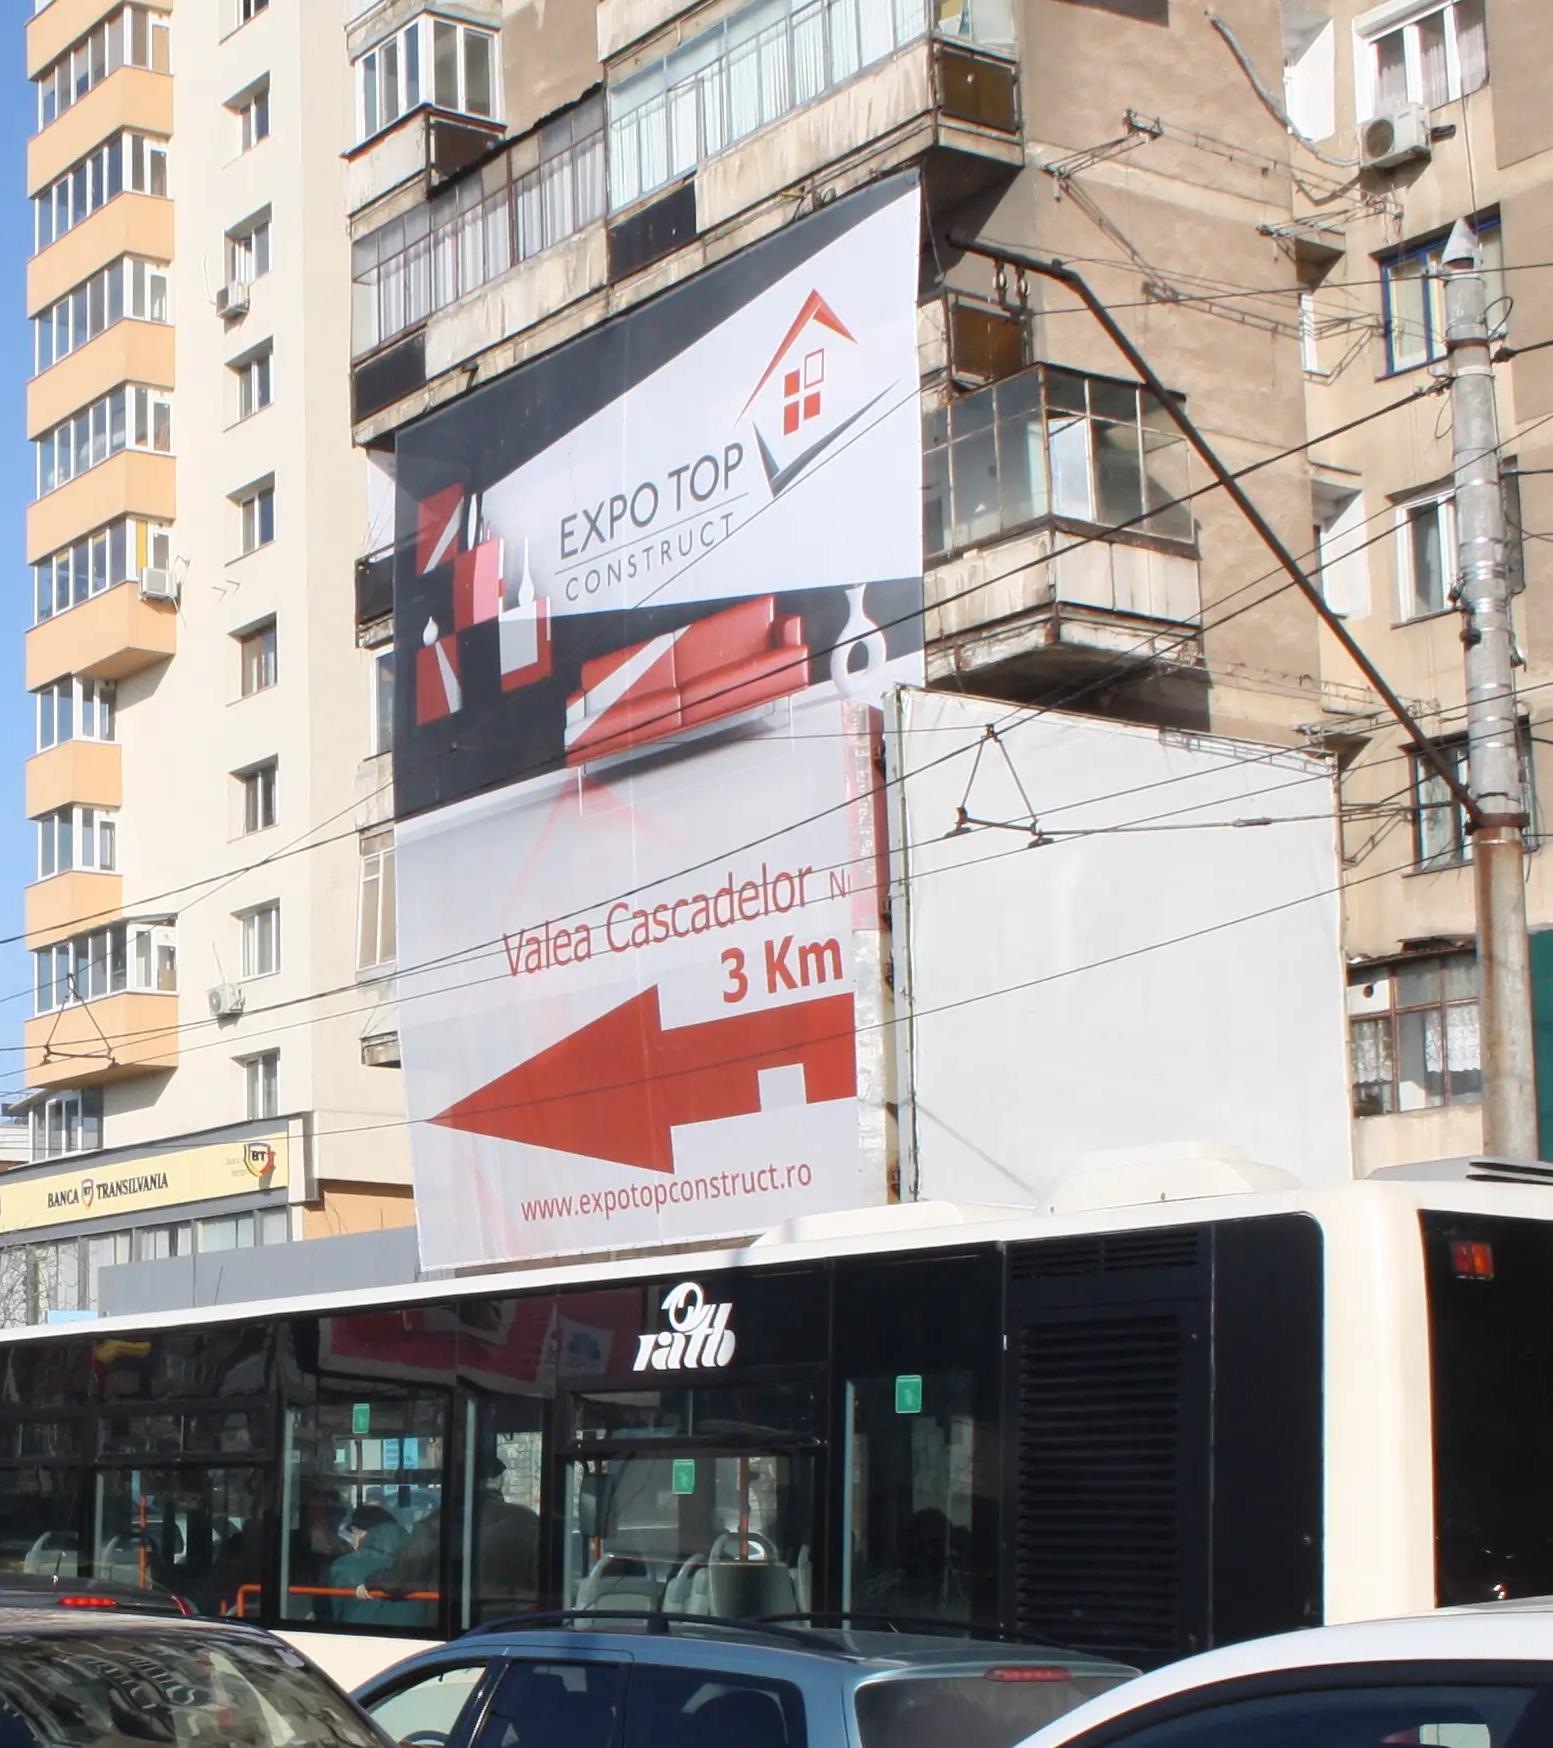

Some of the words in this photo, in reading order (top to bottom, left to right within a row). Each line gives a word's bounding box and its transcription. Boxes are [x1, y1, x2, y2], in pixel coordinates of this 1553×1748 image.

[561, 482, 659, 560] EXPO
[667, 443, 744, 513] TOP
[565, 512, 734, 601] CONSTRUCT
[502, 920, 593, 977] Valea
[606, 862, 813, 953] Cascadelor
[721, 947, 749, 1004] 3
[764, 935, 844, 994] Km
[47, 1187, 79, 1209] BANCA
[96, 1171, 169, 1200] TRANSILVANIA
[521, 1162, 812, 1221] www.expotopconstruct.ro
